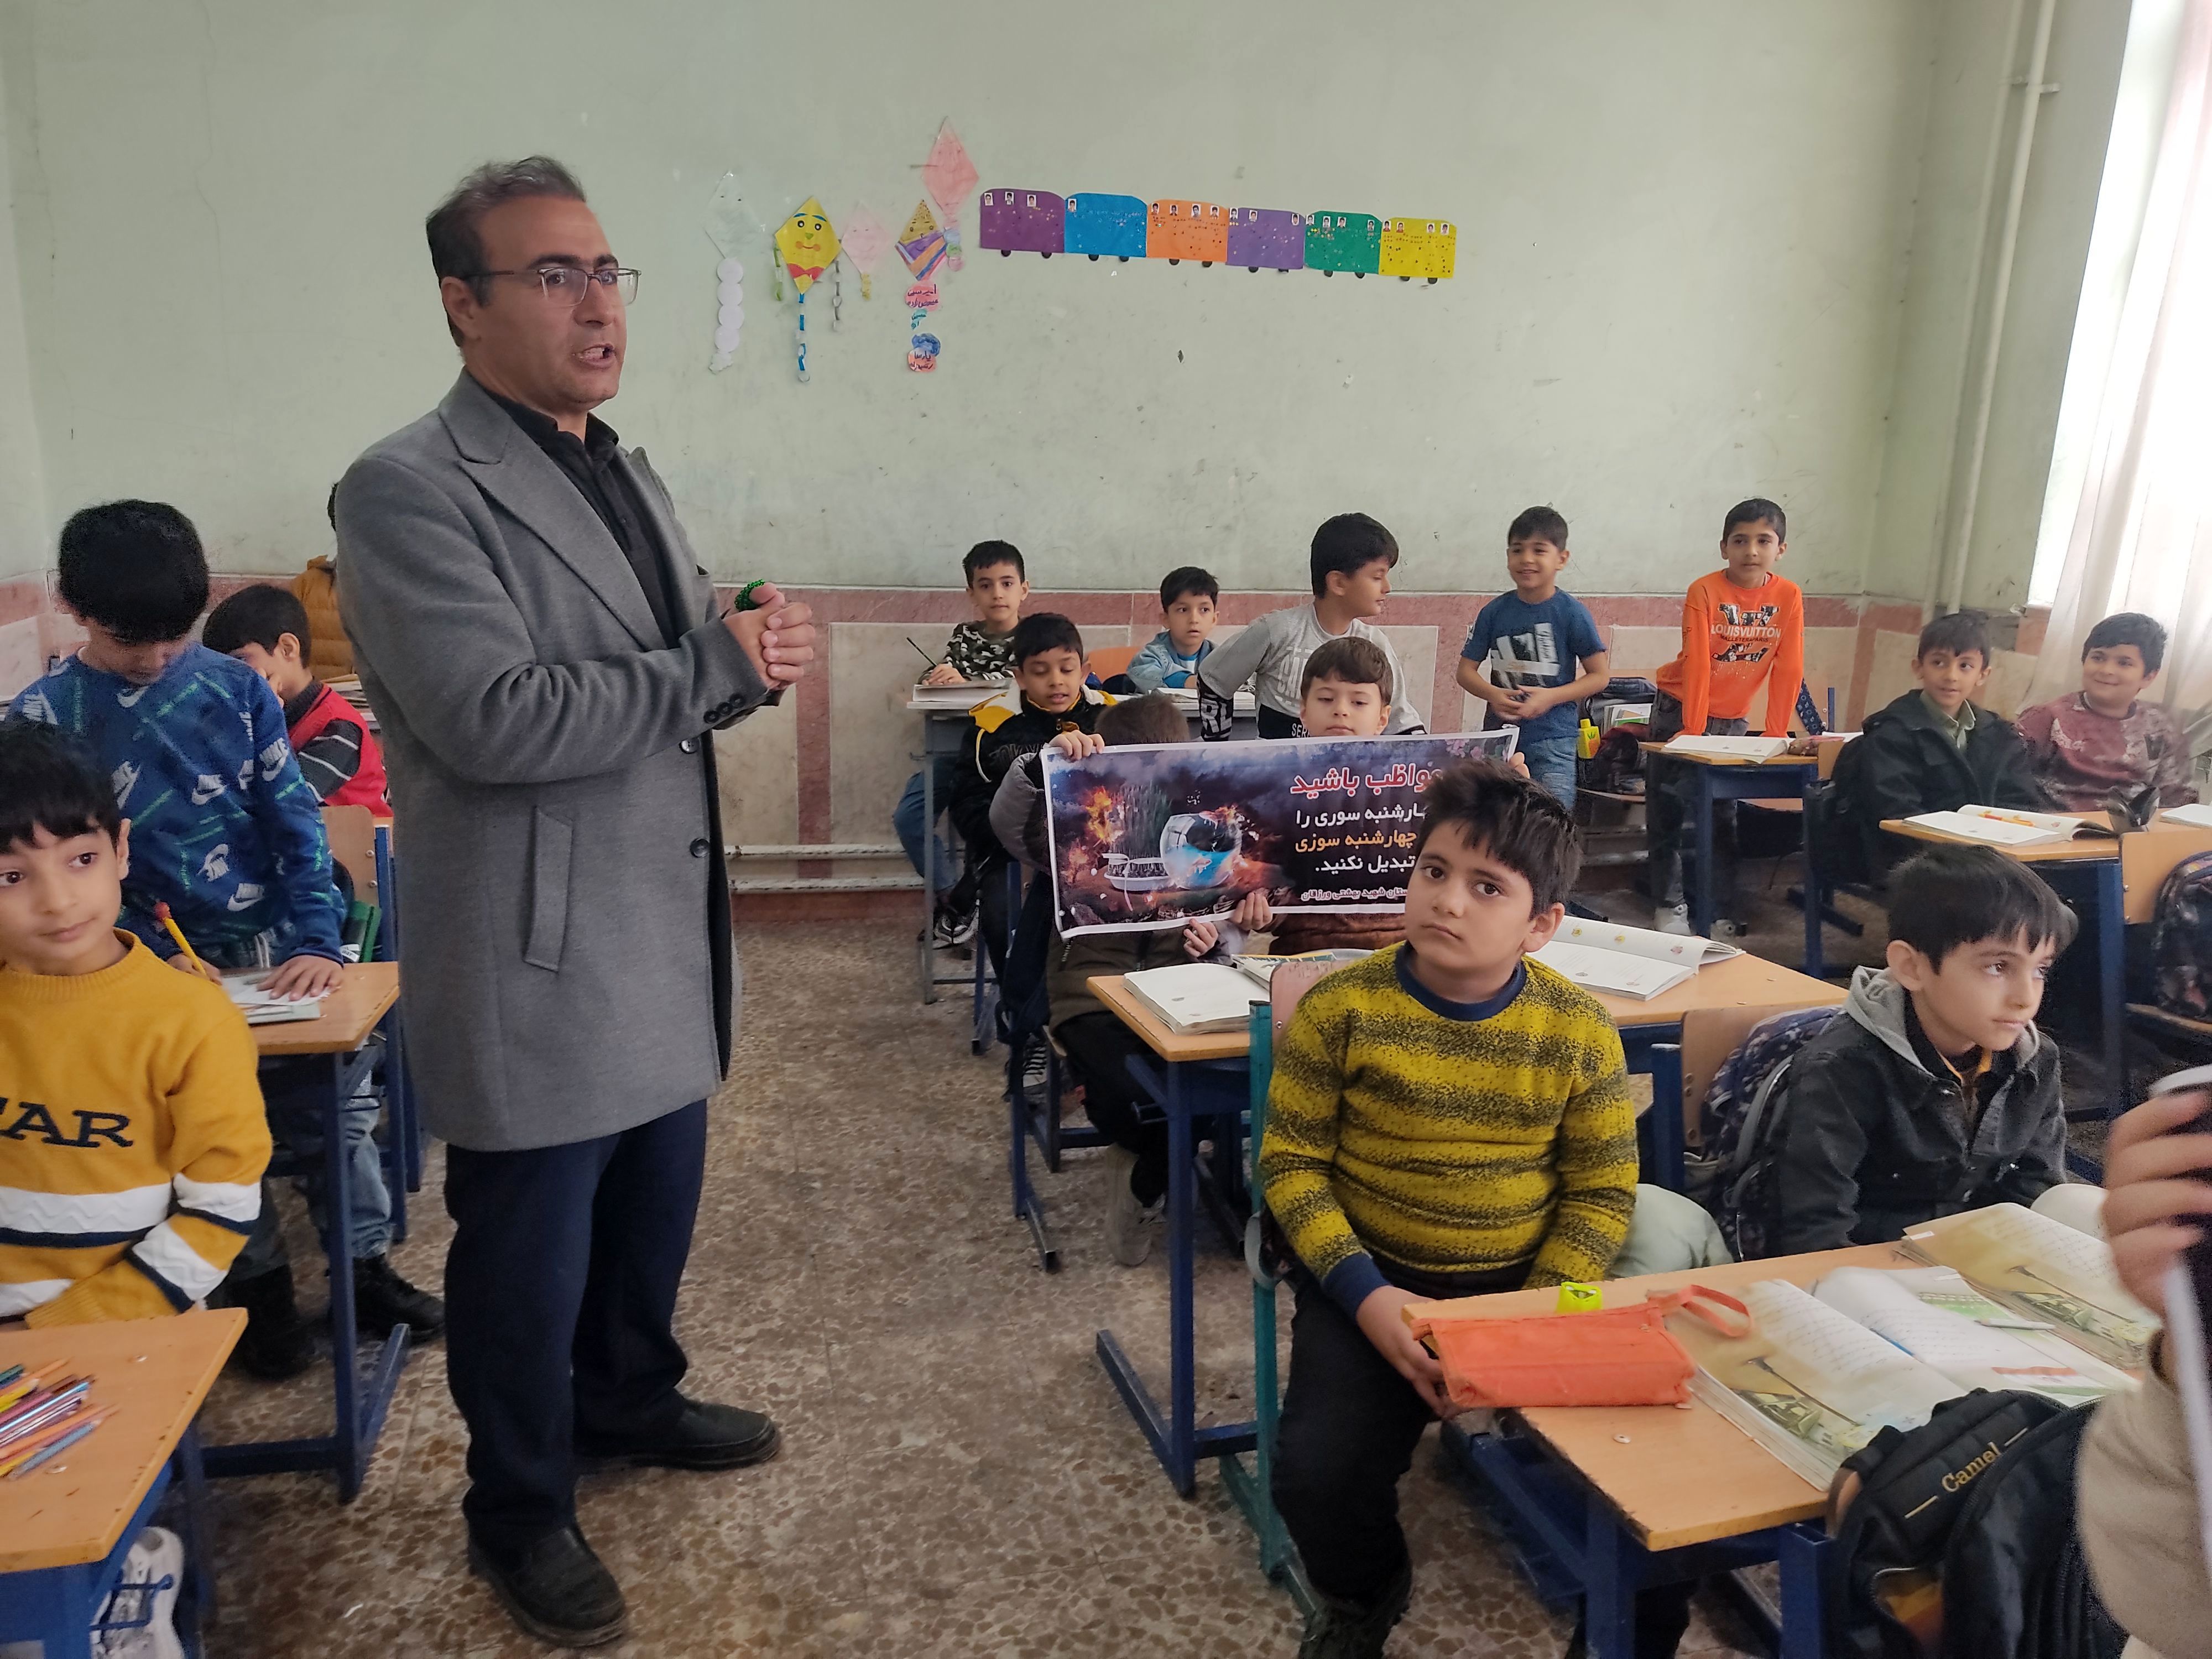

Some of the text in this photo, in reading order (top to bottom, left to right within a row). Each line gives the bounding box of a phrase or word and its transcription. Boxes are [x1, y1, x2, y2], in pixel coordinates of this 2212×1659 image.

[1290, 767, 1360, 799] باشید
[1296, 810, 1310, 828] را
[1314, 811, 1360, 827] سوری
[1295, 830, 1417, 853] چهارشنبه سوزی
[1314, 854, 1416, 875] تبدیل نکنید.
[1332, 888, 1361, 901] بهشتی
[1361, 886, 1386, 900] شهید
[1942, 1441, 2001, 1492] Camel
